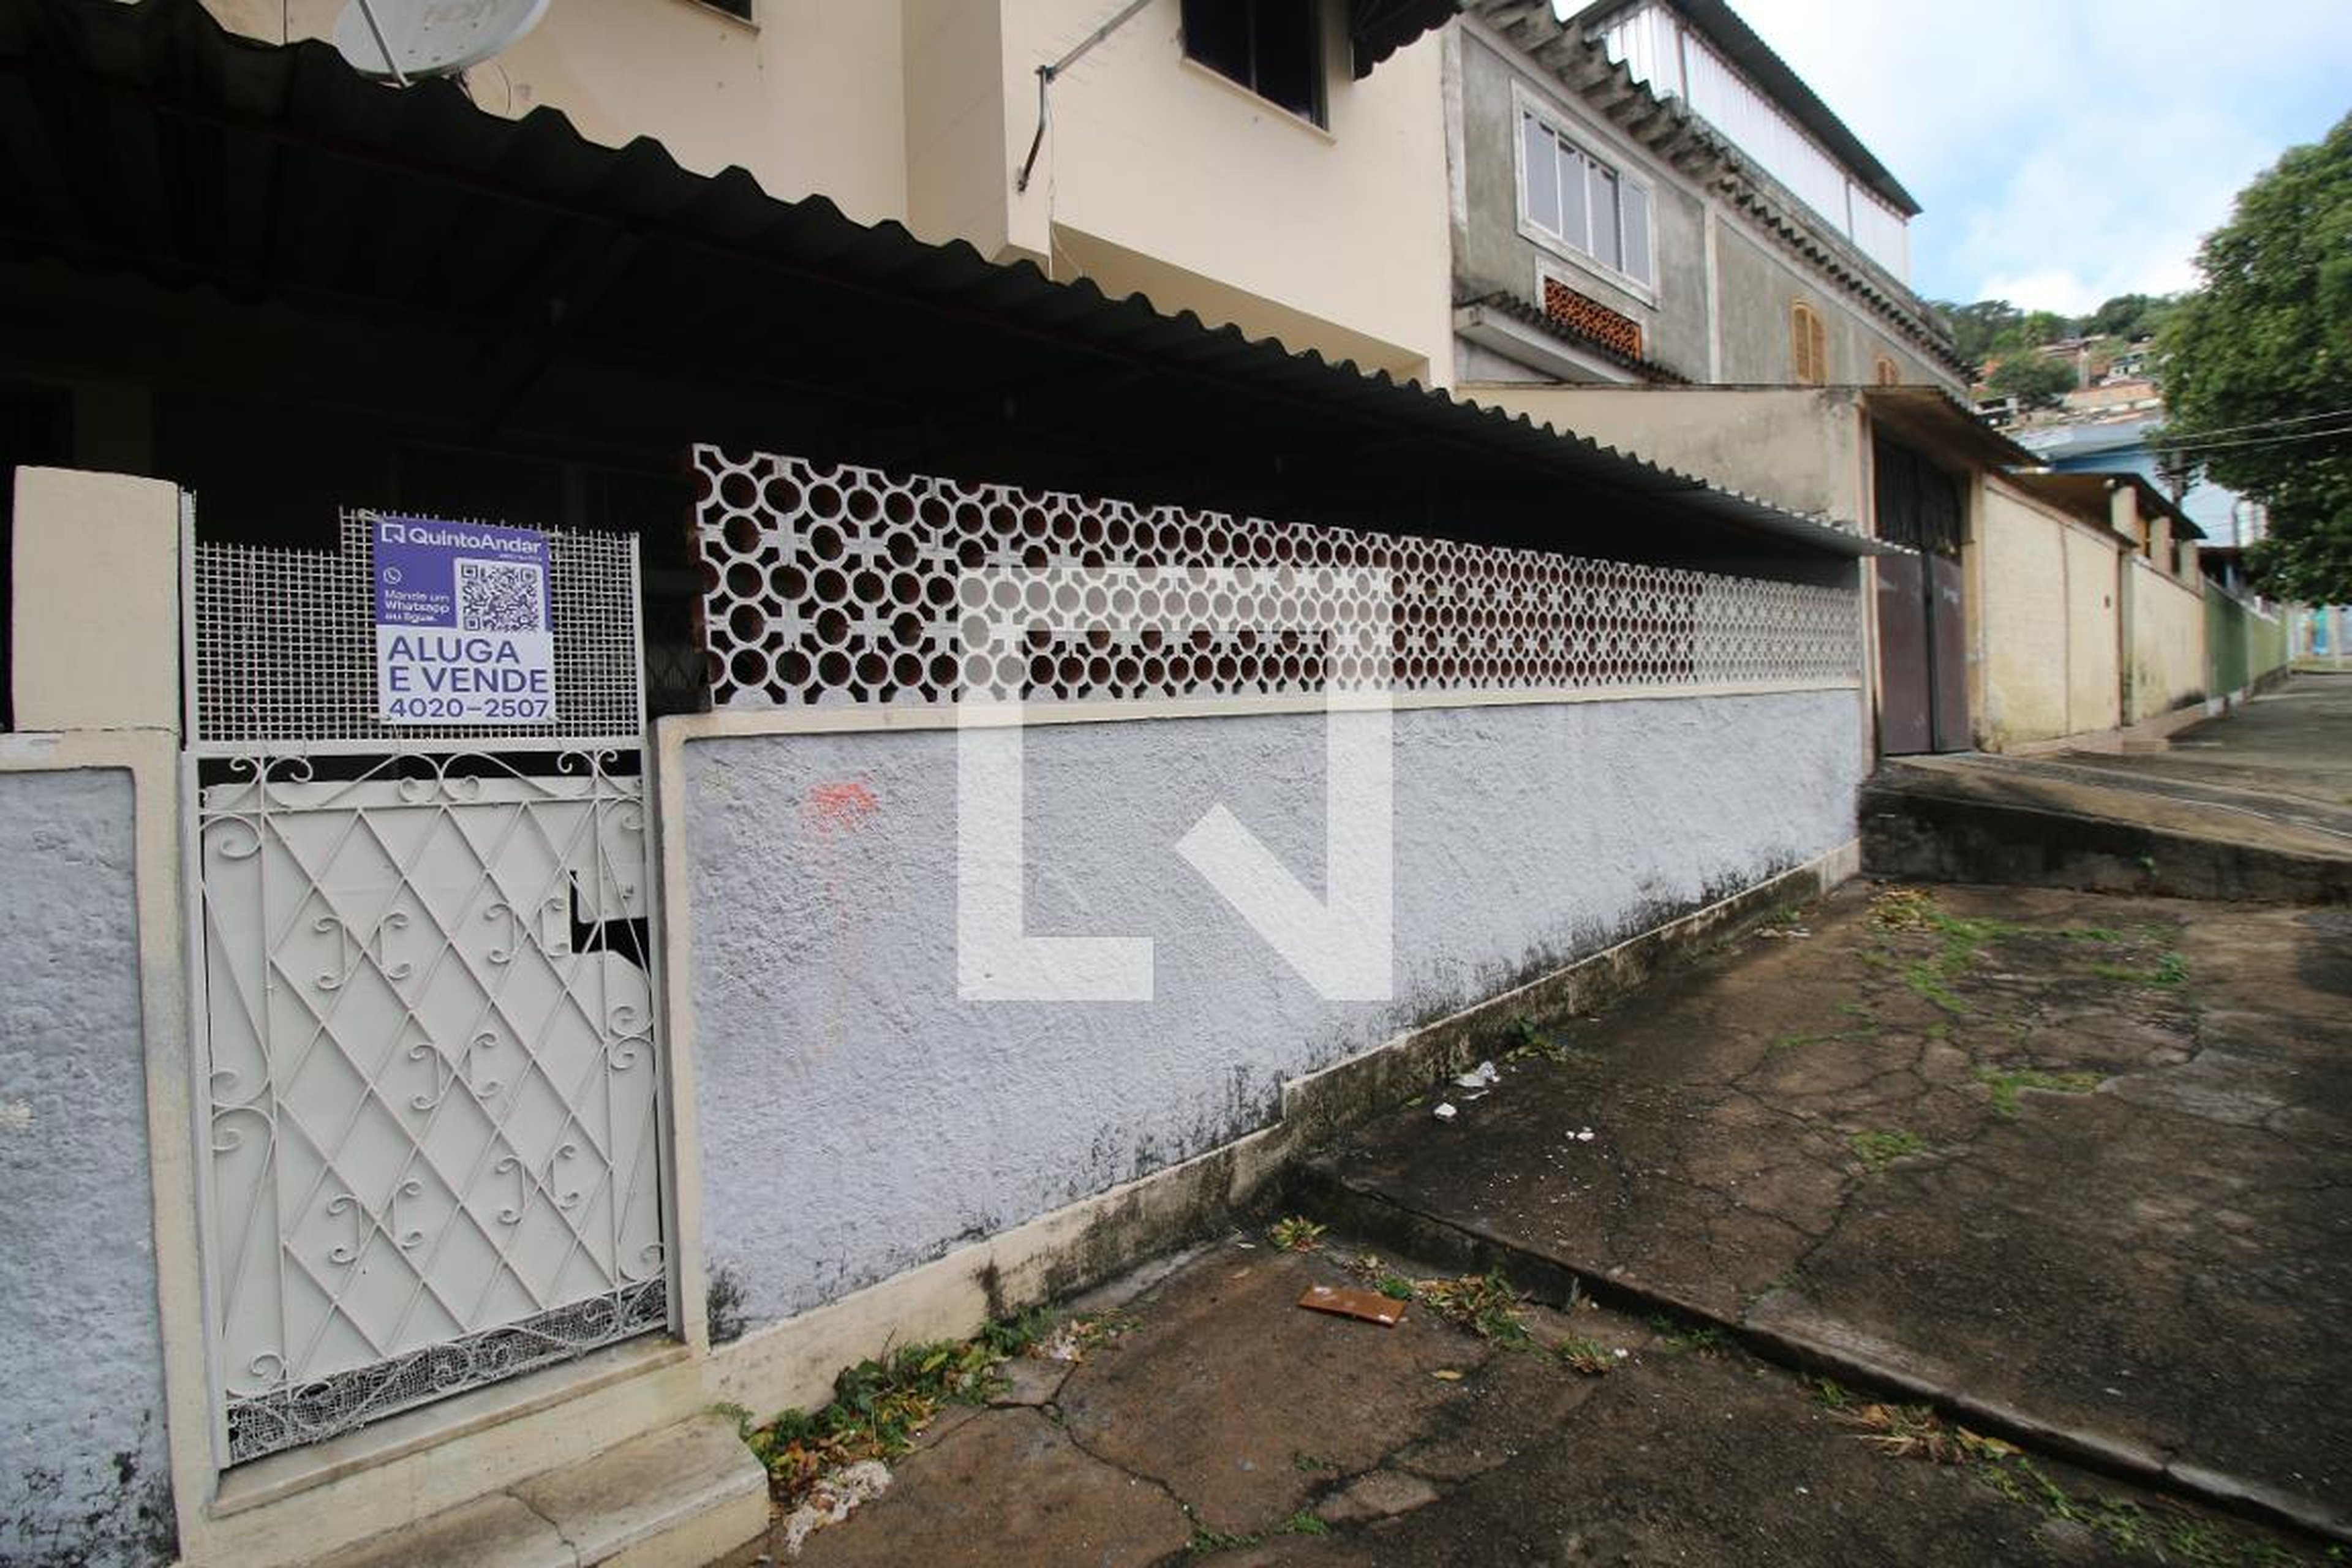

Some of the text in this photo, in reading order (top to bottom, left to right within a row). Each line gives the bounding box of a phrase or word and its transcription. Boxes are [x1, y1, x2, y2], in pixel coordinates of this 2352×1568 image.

[409, 527, 542, 554] QuintoAndar
[388, 636, 520, 664] ALUGA
[390, 666, 549, 693] E VENDE
[389, 698, 549, 718] 4020-2507
